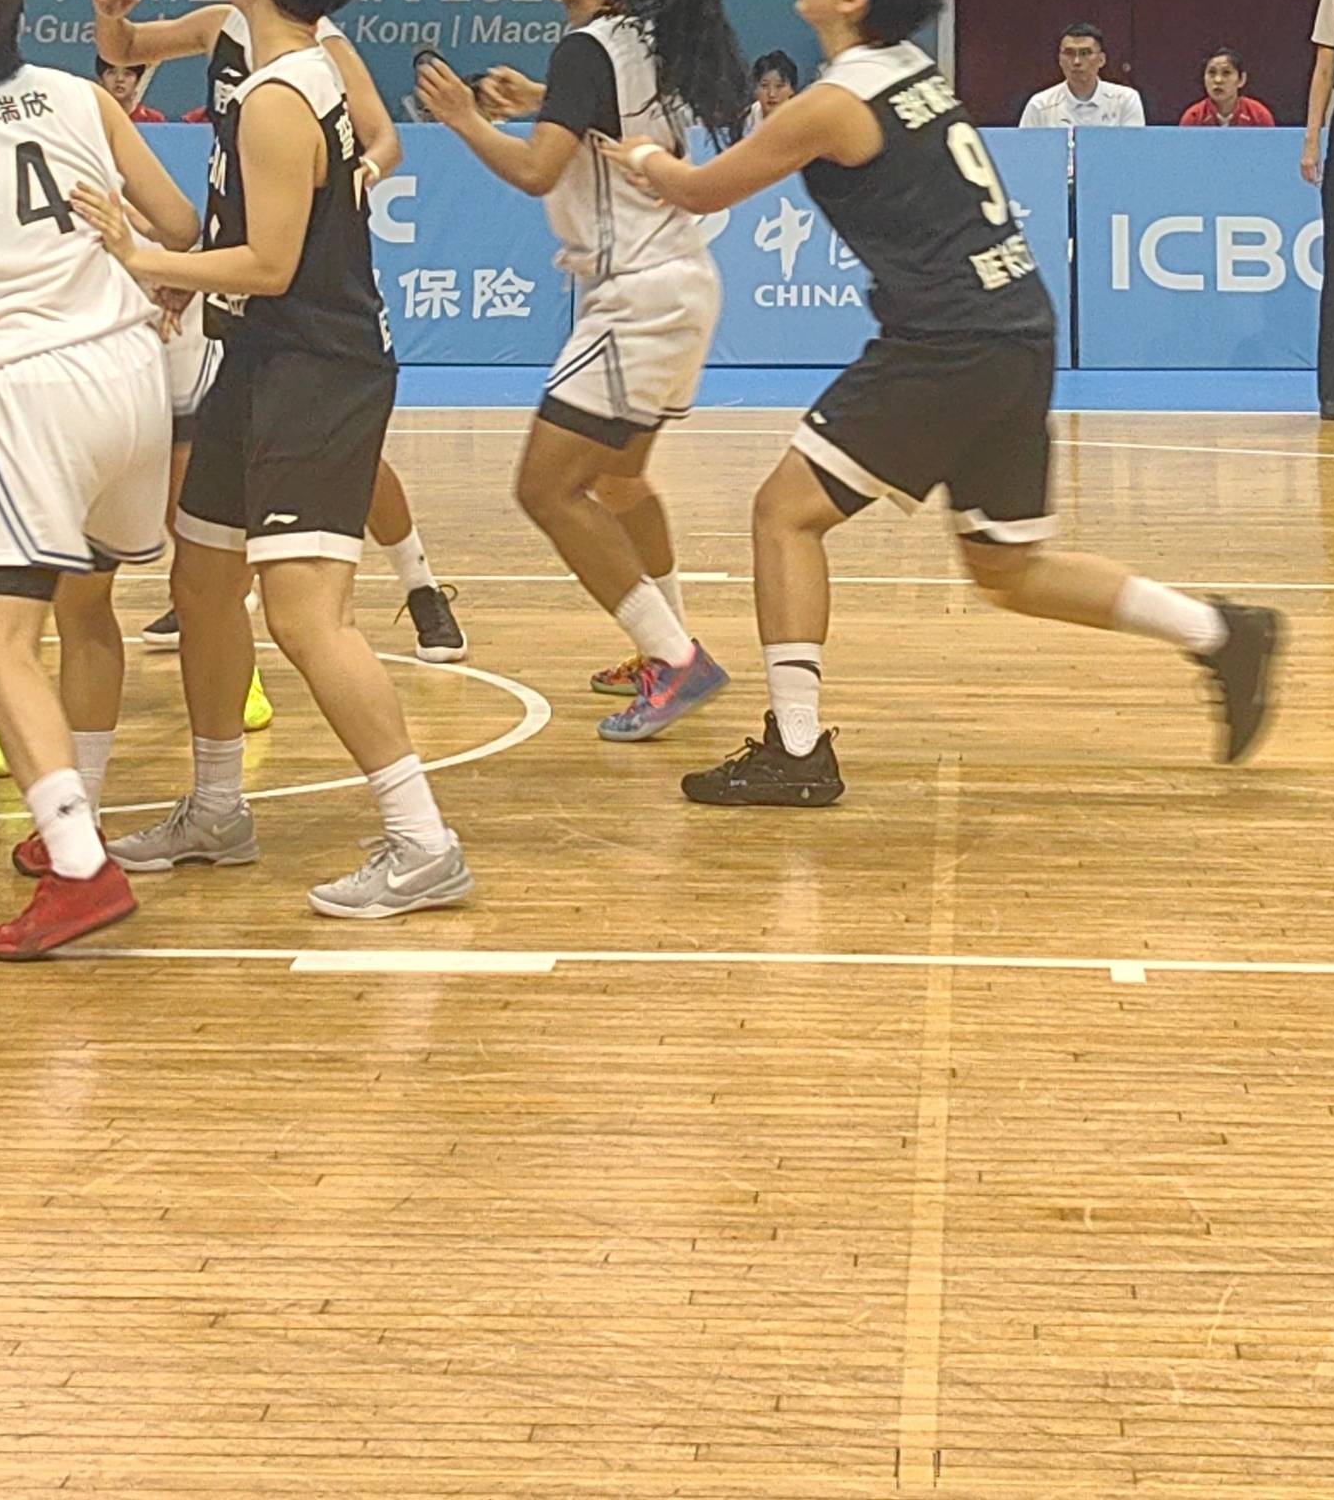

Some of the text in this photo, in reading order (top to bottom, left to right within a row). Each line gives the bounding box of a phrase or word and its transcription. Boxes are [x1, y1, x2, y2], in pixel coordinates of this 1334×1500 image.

[470, 14, 571, 44] Maca
[15, 140, 77, 235] 4
[946, 121, 1009, 226] 9
[753, 284, 864, 308] CHINA
